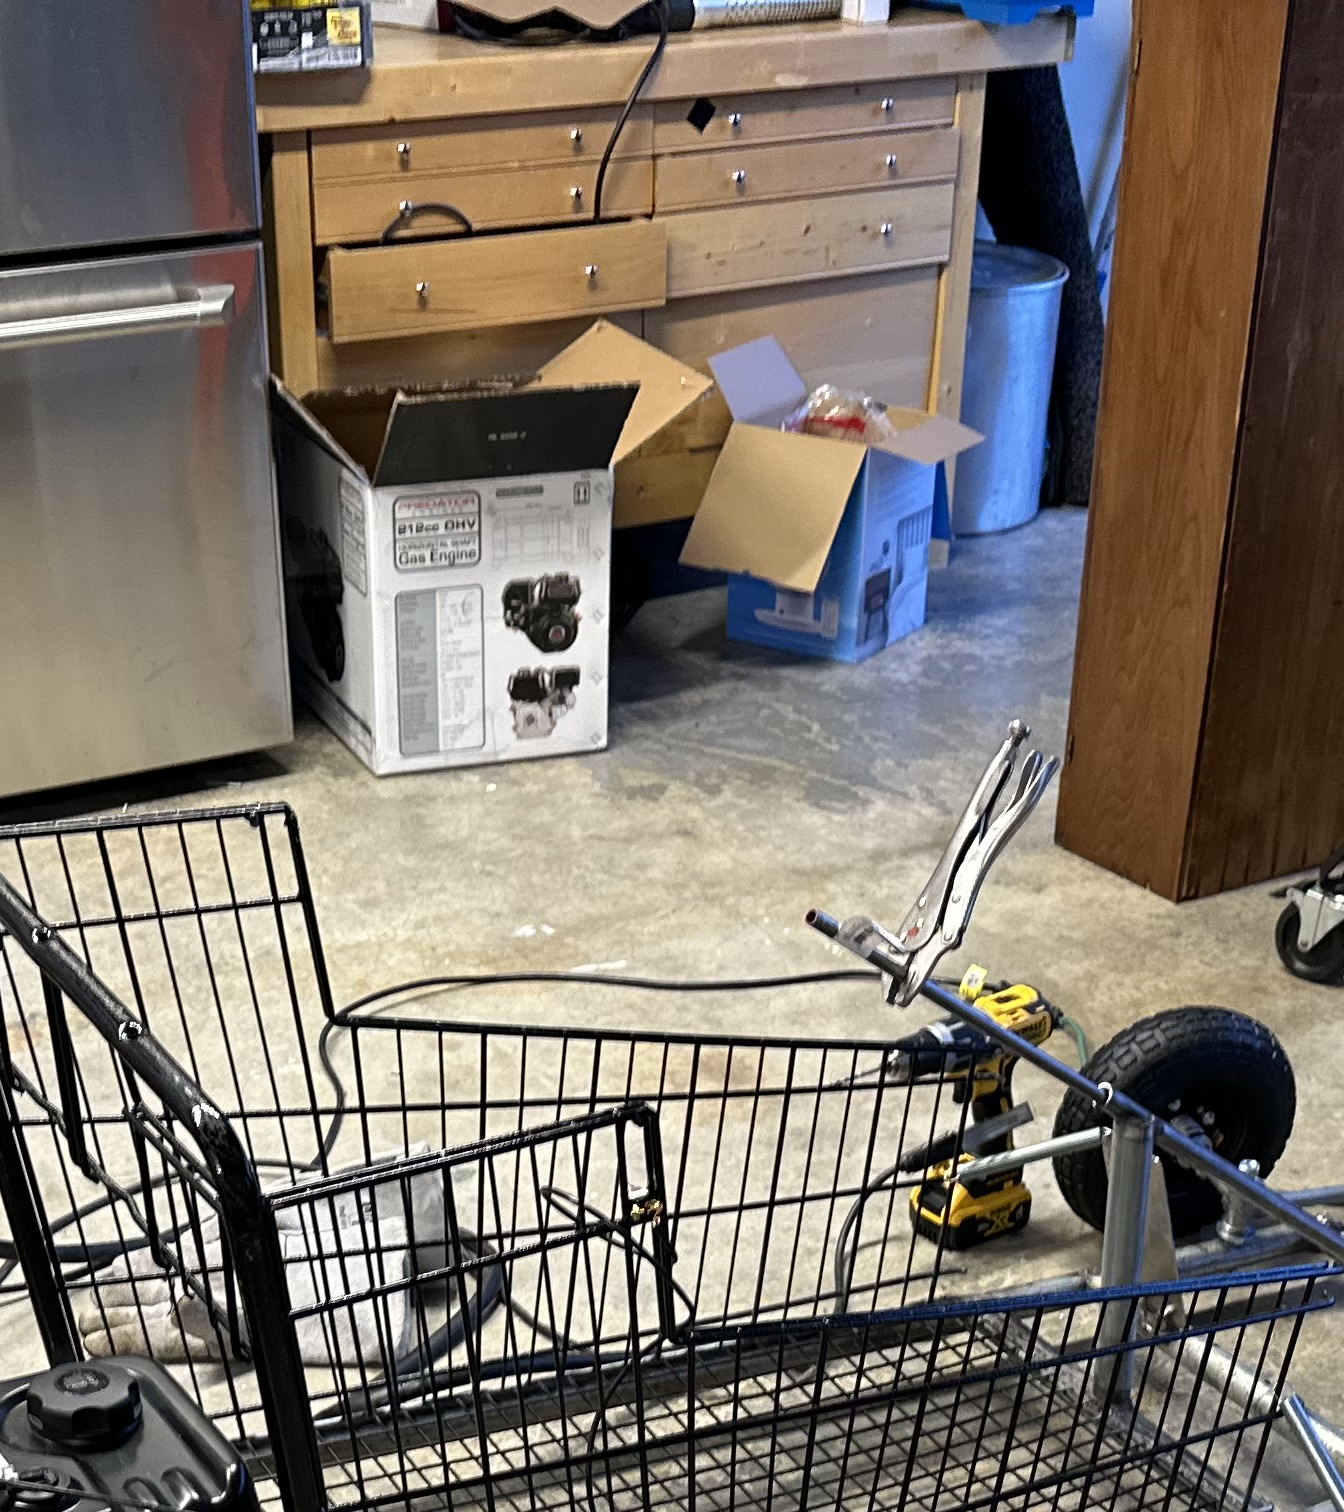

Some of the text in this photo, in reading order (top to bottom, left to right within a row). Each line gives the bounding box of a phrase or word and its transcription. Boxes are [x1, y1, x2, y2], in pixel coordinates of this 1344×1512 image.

[444, 517, 477, 532] OHV
[398, 548, 478, 568] Gas Engine
